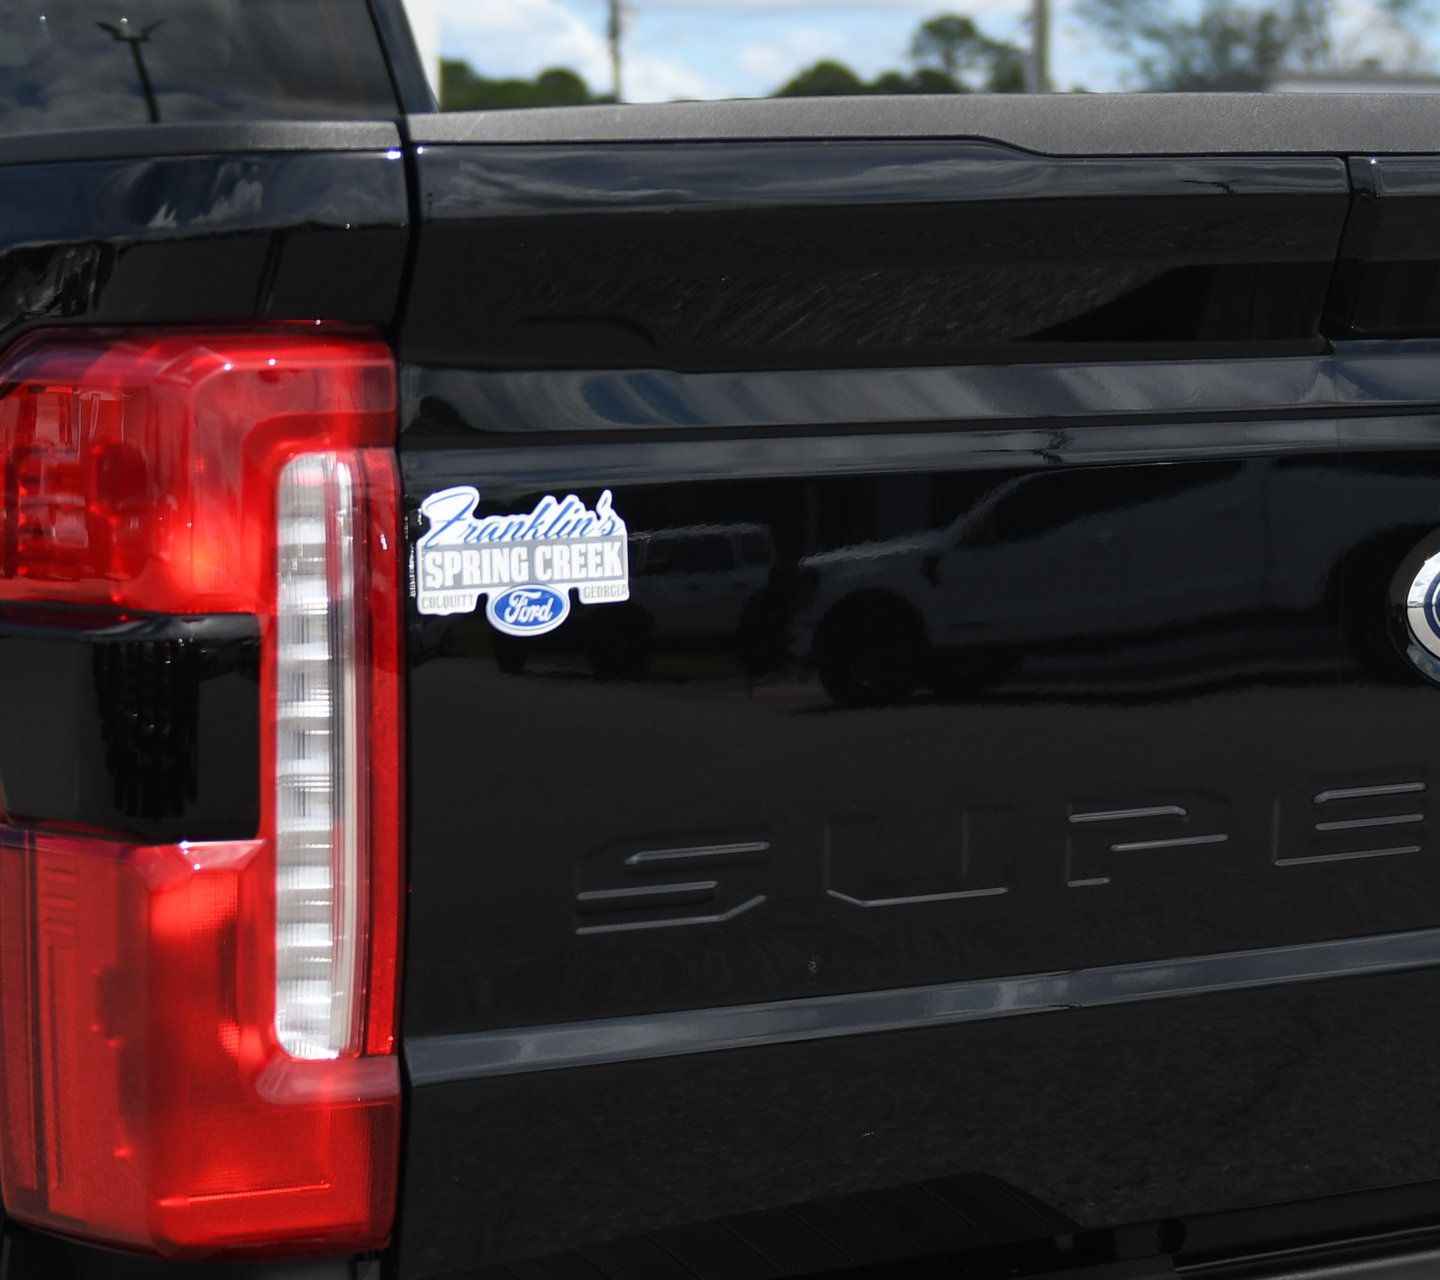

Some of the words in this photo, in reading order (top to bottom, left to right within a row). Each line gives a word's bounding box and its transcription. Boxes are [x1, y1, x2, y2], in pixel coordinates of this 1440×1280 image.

[423, 491, 622, 549] Franklin's
[424, 546, 530, 589] SPRING
[534, 541, 623, 581] CREEK
[503, 590, 554, 624] Ford
[582, 584, 628, 600] GEORGIA
